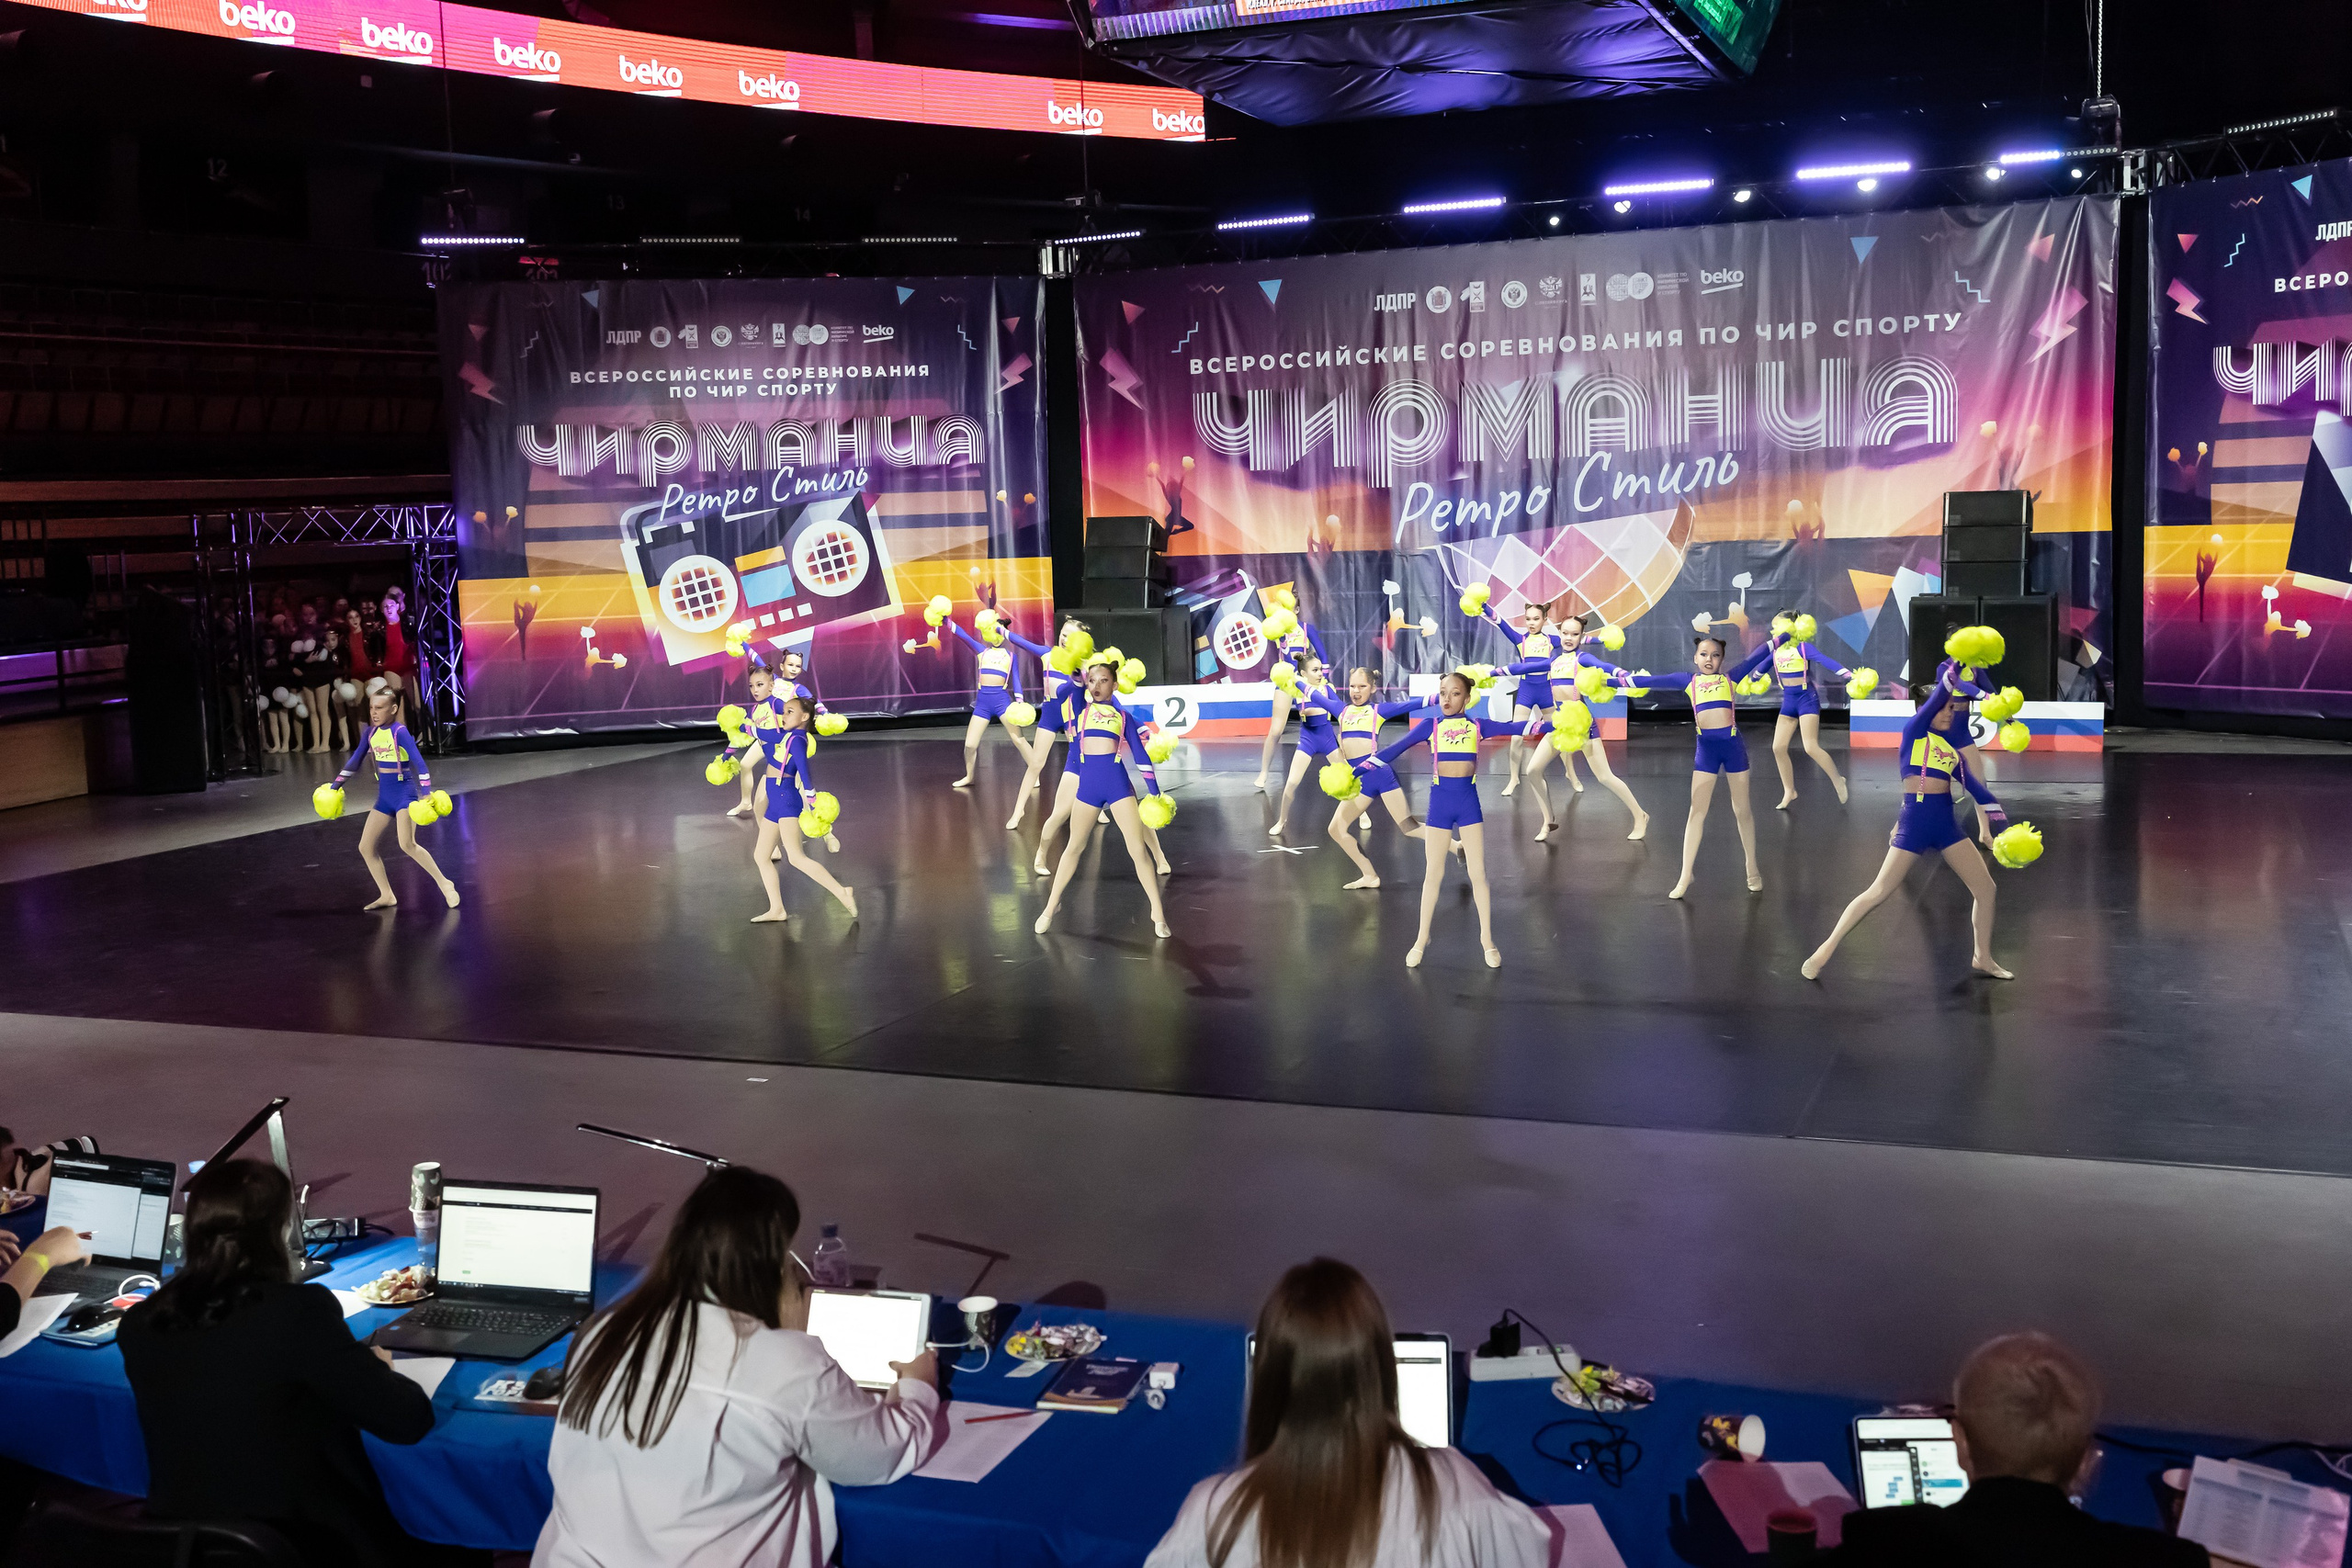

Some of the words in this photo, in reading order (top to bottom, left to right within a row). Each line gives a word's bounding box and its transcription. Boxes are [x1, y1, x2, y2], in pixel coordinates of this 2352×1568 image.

[219, 0, 296, 35] beko
[361, 17, 433, 54] beko
[493, 37, 561, 73] beko
[618, 54, 683, 88] beko
[738, 70, 800, 101] beko
[1048, 101, 1103, 127] beko
[1152, 108, 1205, 133] beko
[1700, 268, 1744, 285] beko
[2274, 271, 2349, 292] ВСЕРО
[1374, 293, 1416, 312] ЛДПР
[605, 330, 642, 345] ЛДПР
[863, 324, 895, 339] beko
[1190, 345, 1427, 375] ВСЕРОССИЙСКИЕ
[1441, 329, 1683, 360] СОРЕВНОВАНИЯ
[1700, 326, 1740, 344] ПО
[1755, 321, 1817, 341] ЧИР
[1833, 312, 1962, 337] СПОРТУ
[571, 367, 753, 384] ВСЕРОССИЙСКИЕ
[763, 365, 930, 380] СОРЕВНОВАНИЯ
[2213, 334, 2352, 416] ЧИ
[670, 385, 696, 399] ПО
[707, 384, 748, 398] ЧИР
[757, 383, 837, 397] СПОРТУ
[660, 483, 759, 522] Ретро
[771, 466, 869, 502] Стиль
[1395, 482, 1551, 545] Ретро
[1573, 451, 1739, 513] Стиль
[1165, 697, 1187, 728] 2
[1970, 712, 1985, 739] 3
